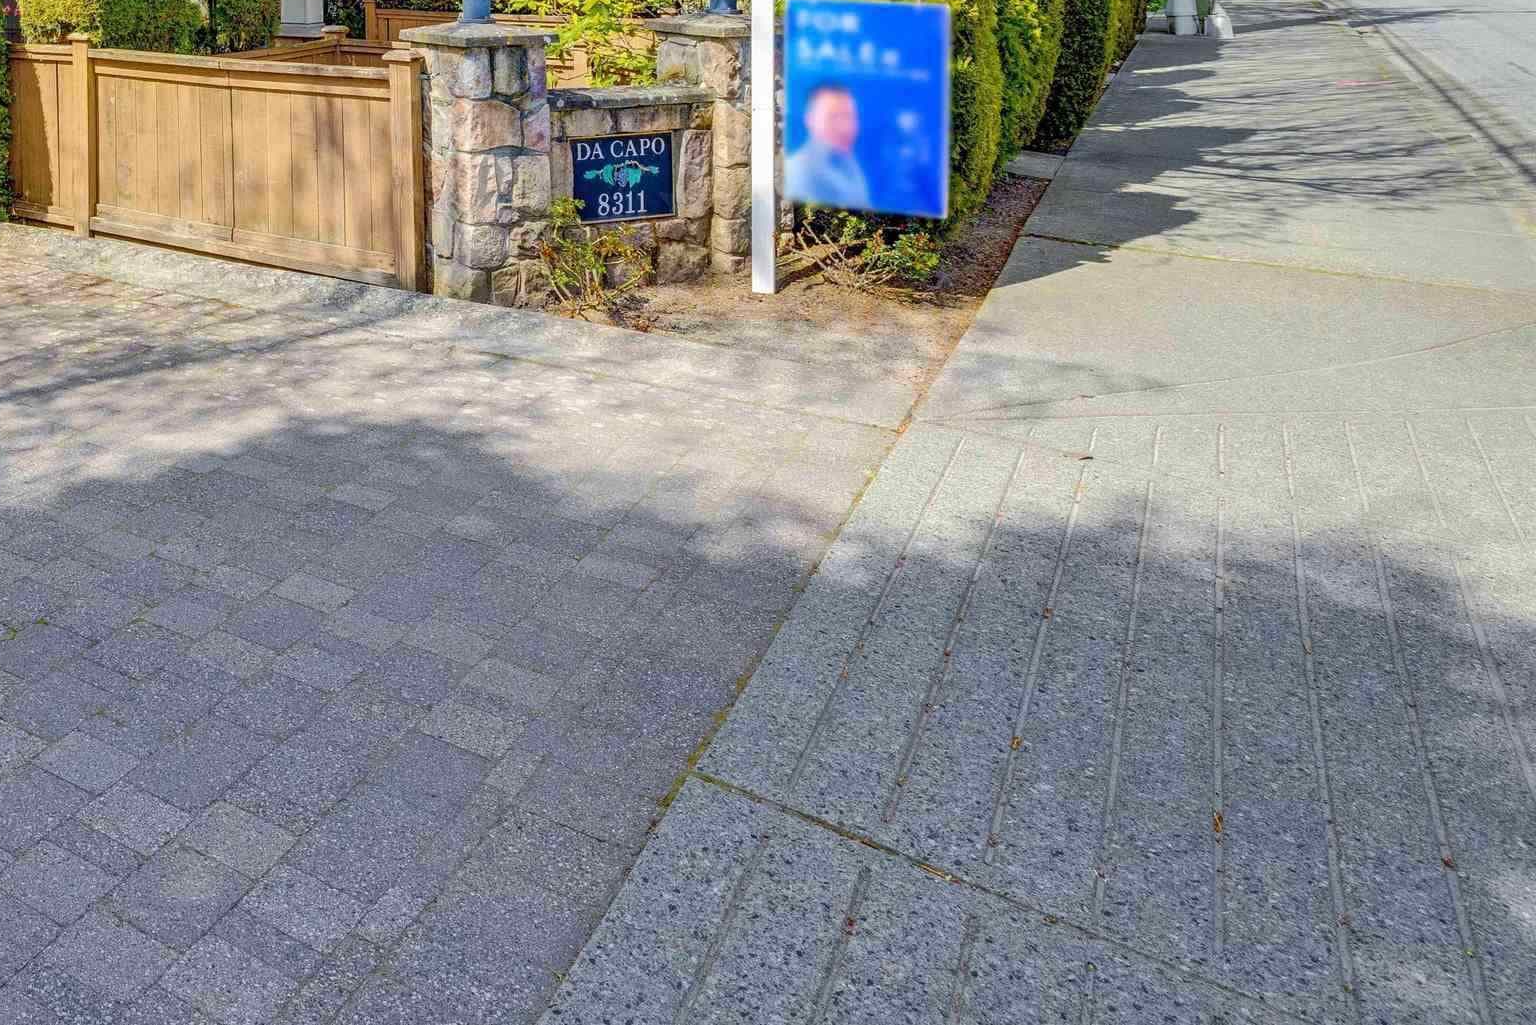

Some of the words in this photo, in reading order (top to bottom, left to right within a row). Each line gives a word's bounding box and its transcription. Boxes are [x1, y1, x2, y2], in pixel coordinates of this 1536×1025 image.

[576, 142, 604, 160] DA
[610, 137, 665, 158] CAPO
[598, 189, 647, 216] 8311
